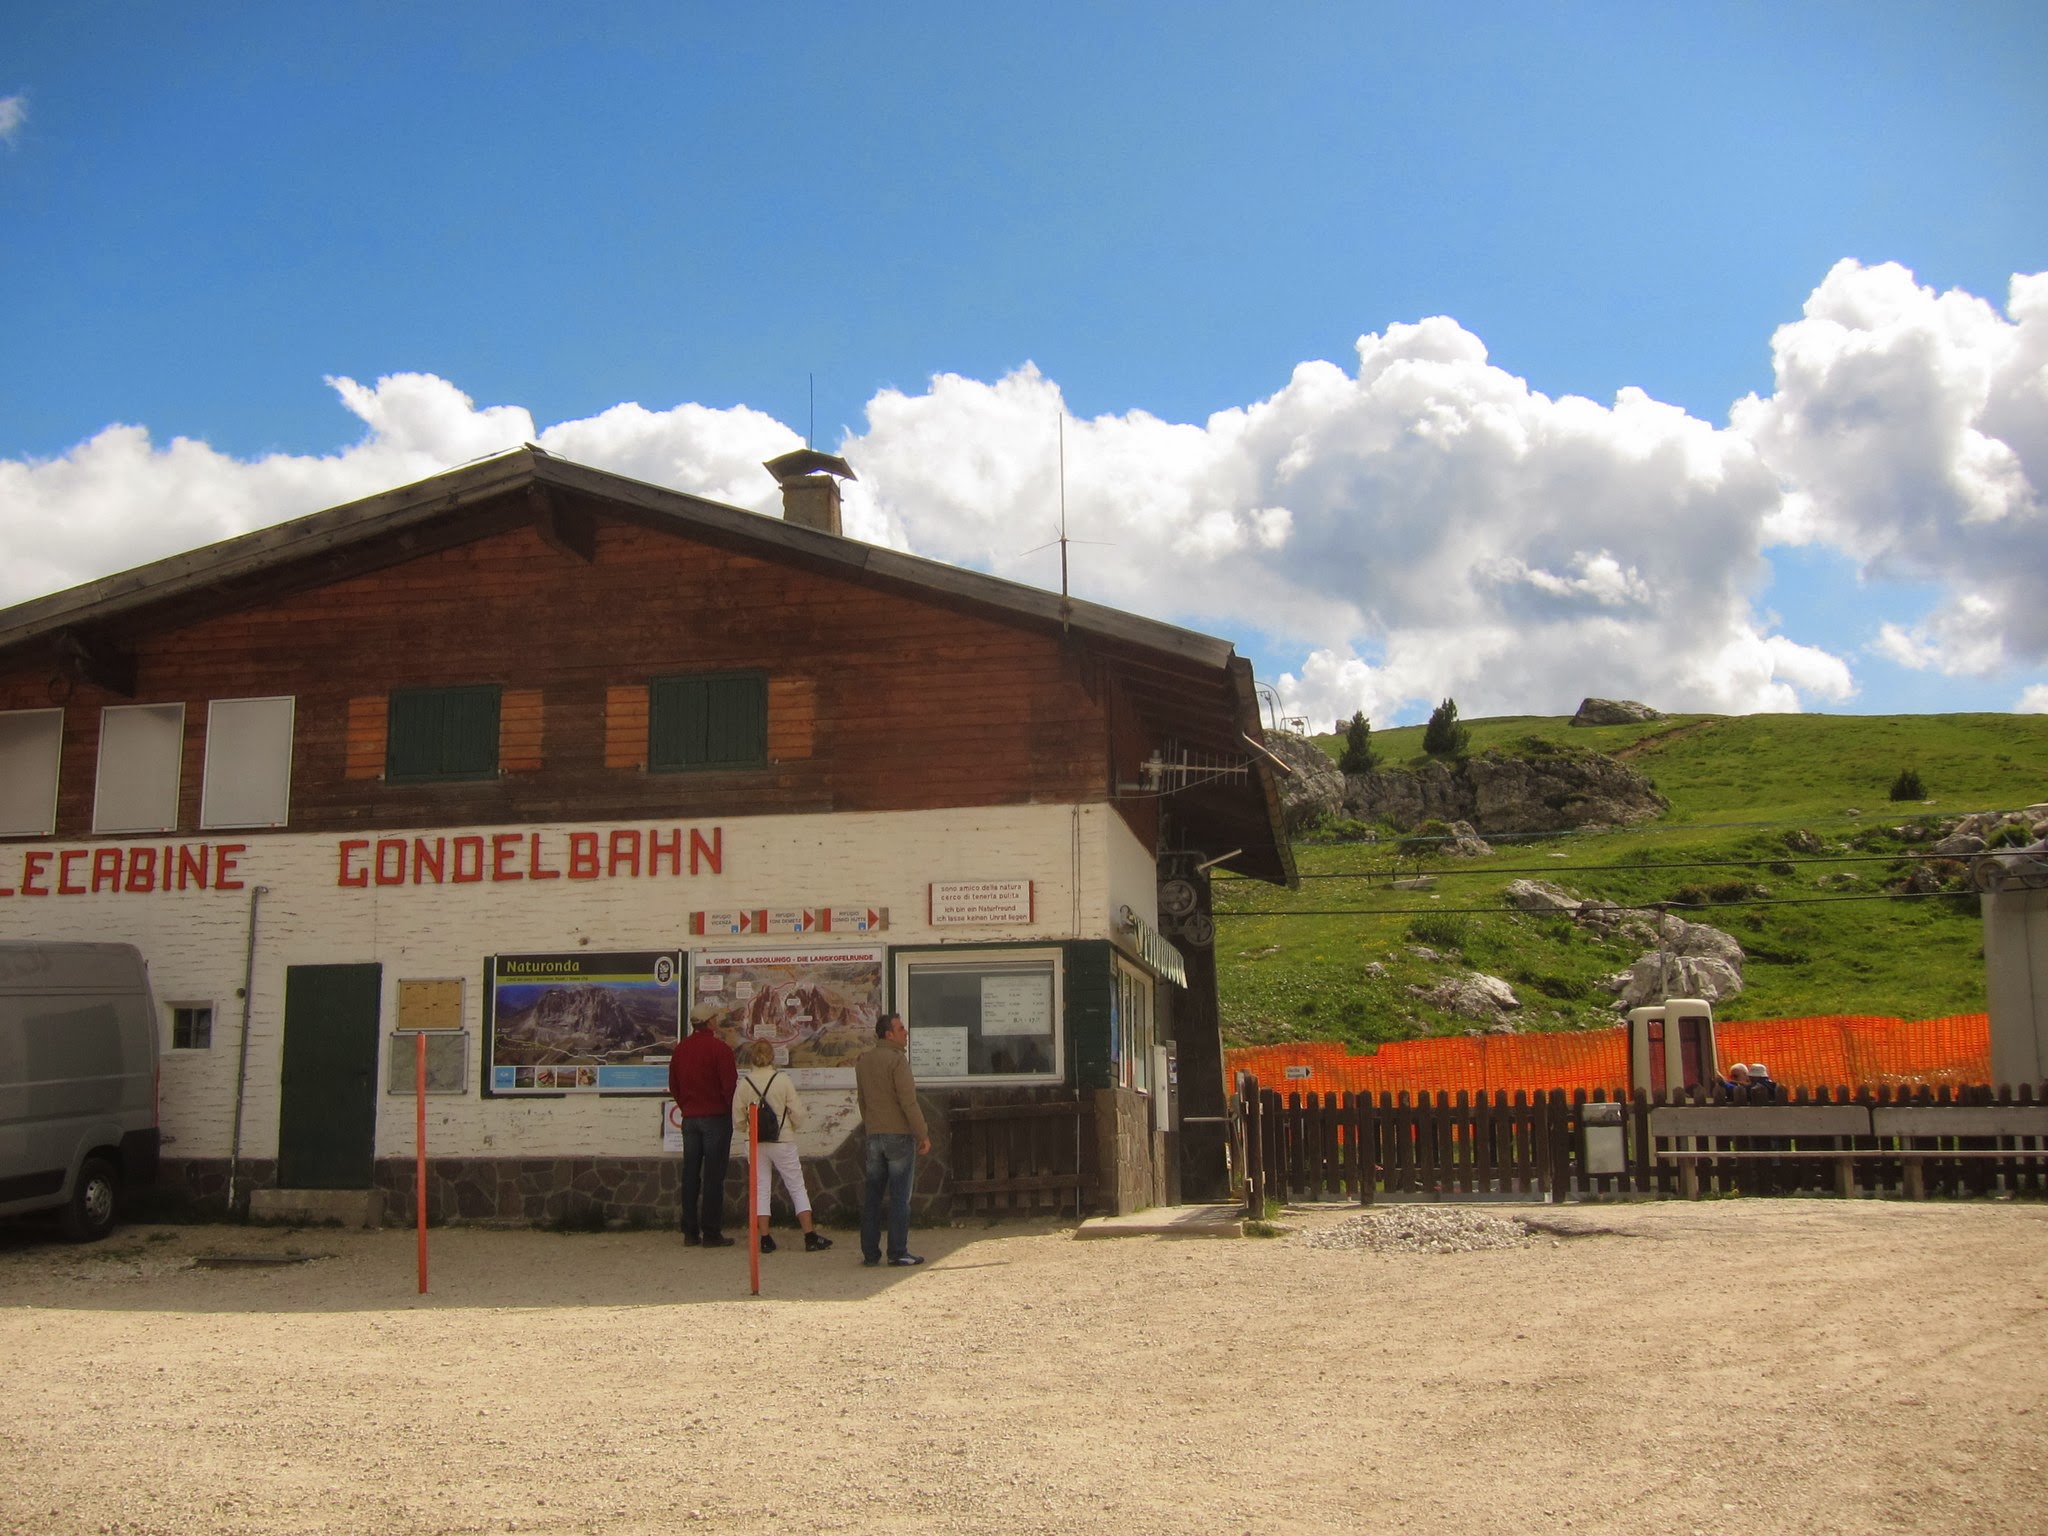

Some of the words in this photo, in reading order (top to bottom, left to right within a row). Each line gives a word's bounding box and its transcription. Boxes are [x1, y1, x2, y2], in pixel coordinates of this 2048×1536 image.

[338, 827, 722, 887] GONDELBAHN
[810, 954, 873, 962] LANGKOFELRUNDE
[506, 960, 580, 973] Naturonda
